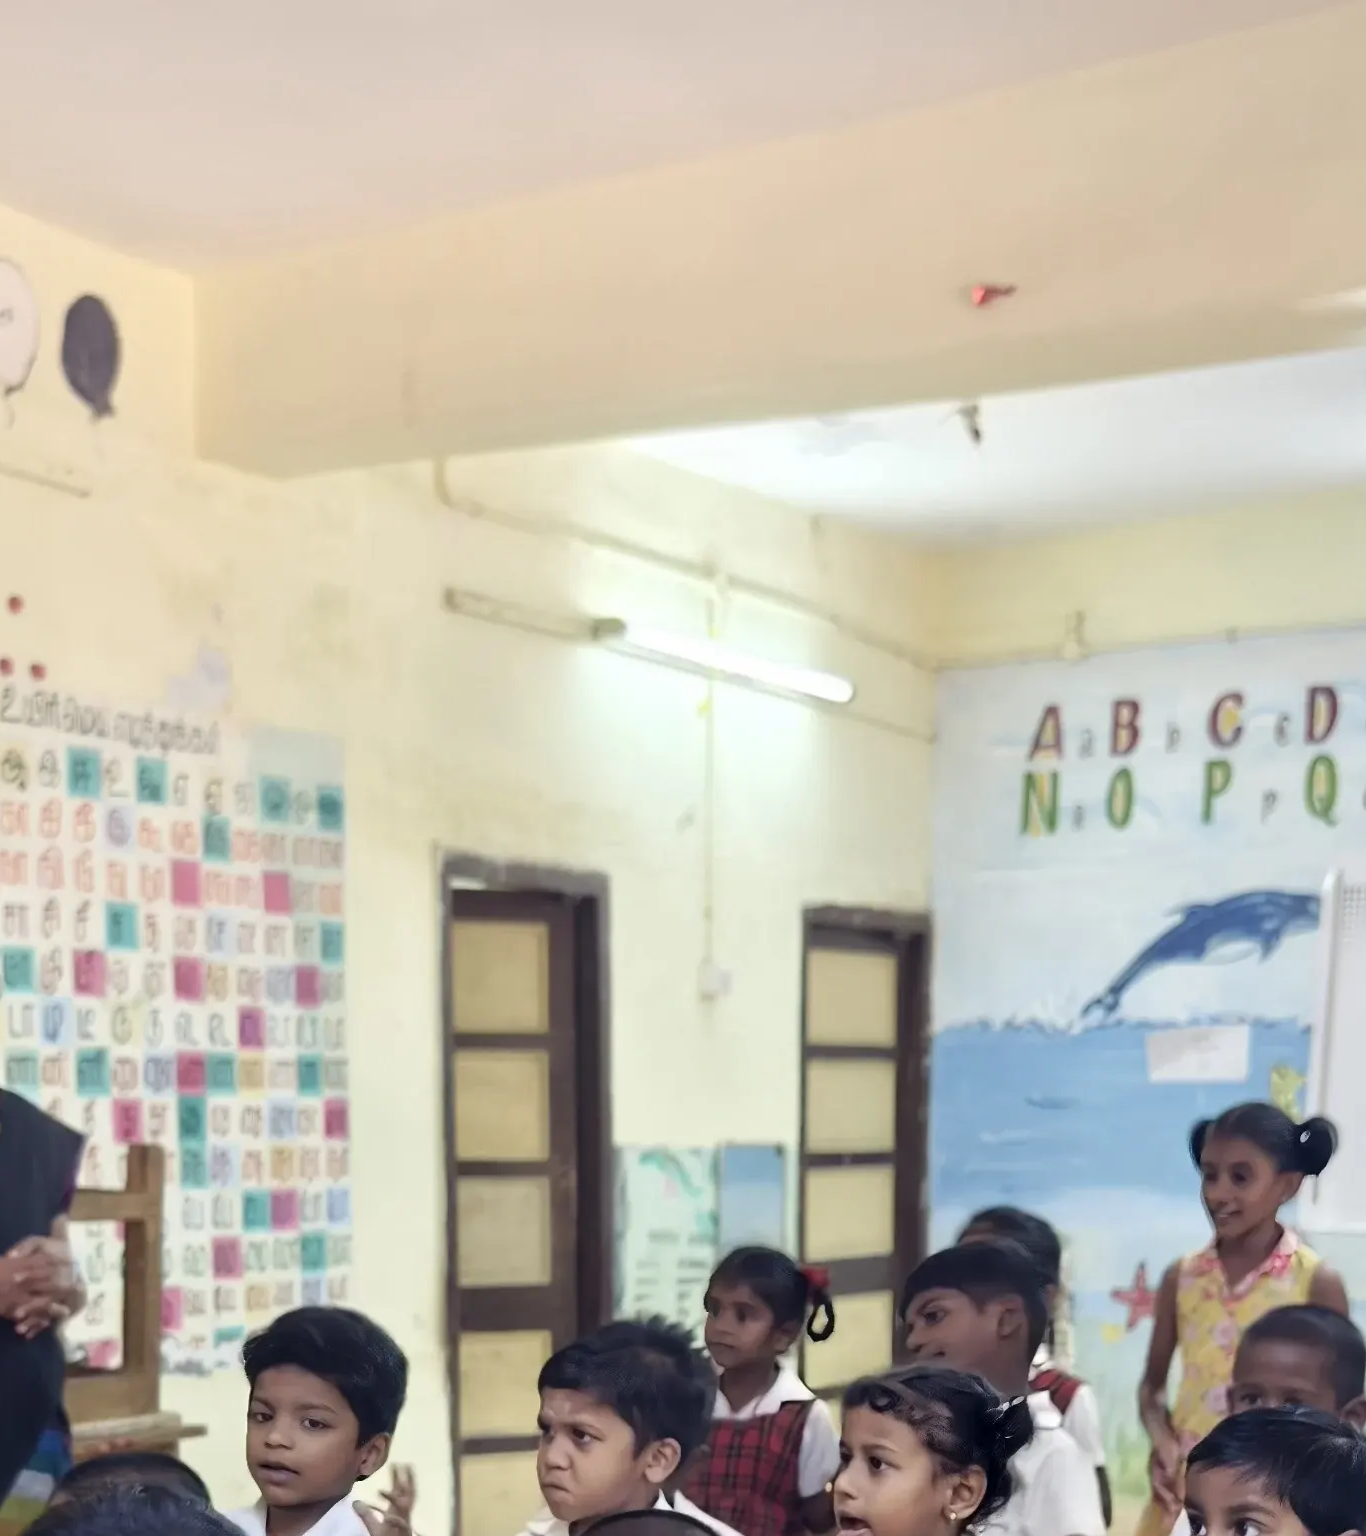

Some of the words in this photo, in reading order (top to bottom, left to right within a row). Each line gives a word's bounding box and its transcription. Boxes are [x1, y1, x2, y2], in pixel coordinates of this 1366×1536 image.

[1028, 704, 1064, 761] A
[1109, 698, 1141, 758] B
[1207, 691, 1245, 749] C
[1303, 683, 1339, 745] D
[1019, 769, 1059, 837] N
[1106, 764, 1135, 832] O
[1201, 760, 1233, 825] P
[1304, 754, 1341, 827] Q
